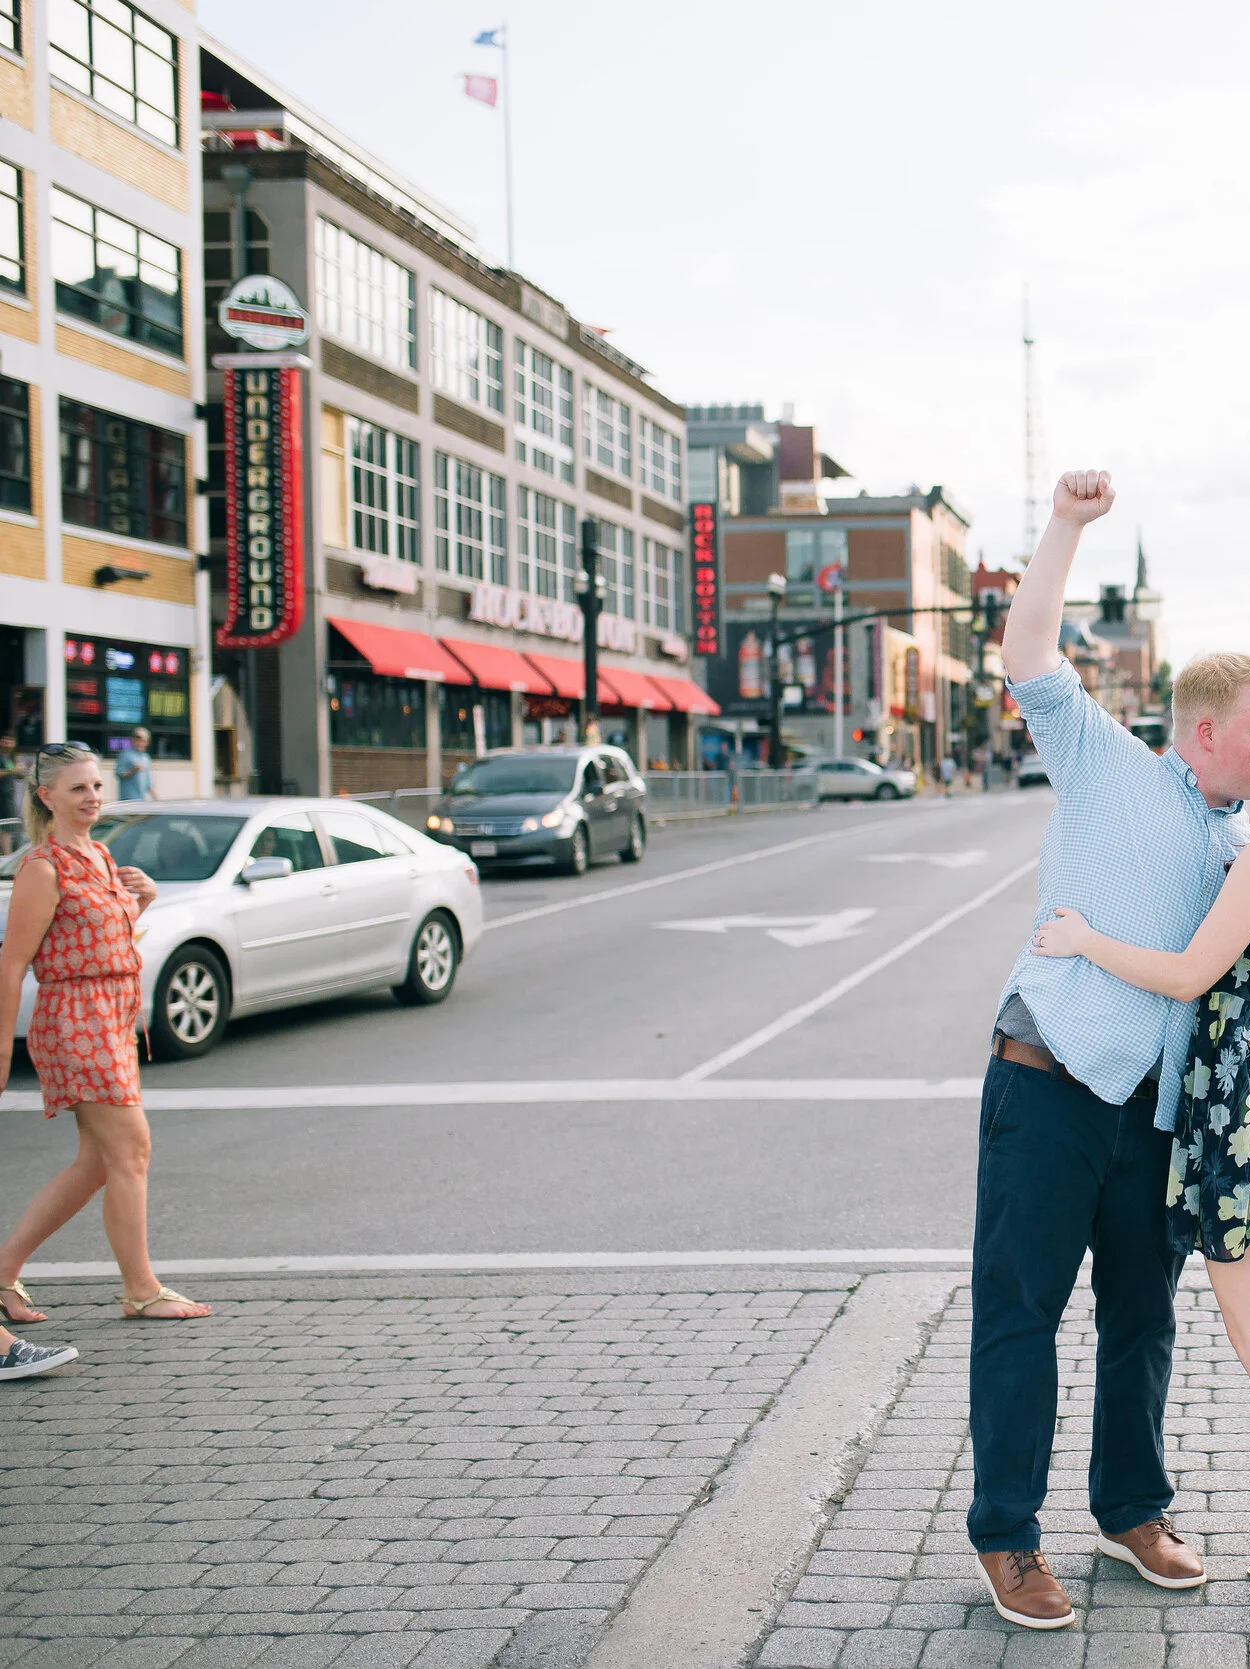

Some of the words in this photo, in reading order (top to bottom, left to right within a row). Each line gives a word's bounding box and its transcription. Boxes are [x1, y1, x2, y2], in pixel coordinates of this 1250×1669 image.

[245, 371, 273, 630] UNDERGROUND
[693, 503, 715, 562] ROCK
[695, 566, 718, 655] BOTTOM
